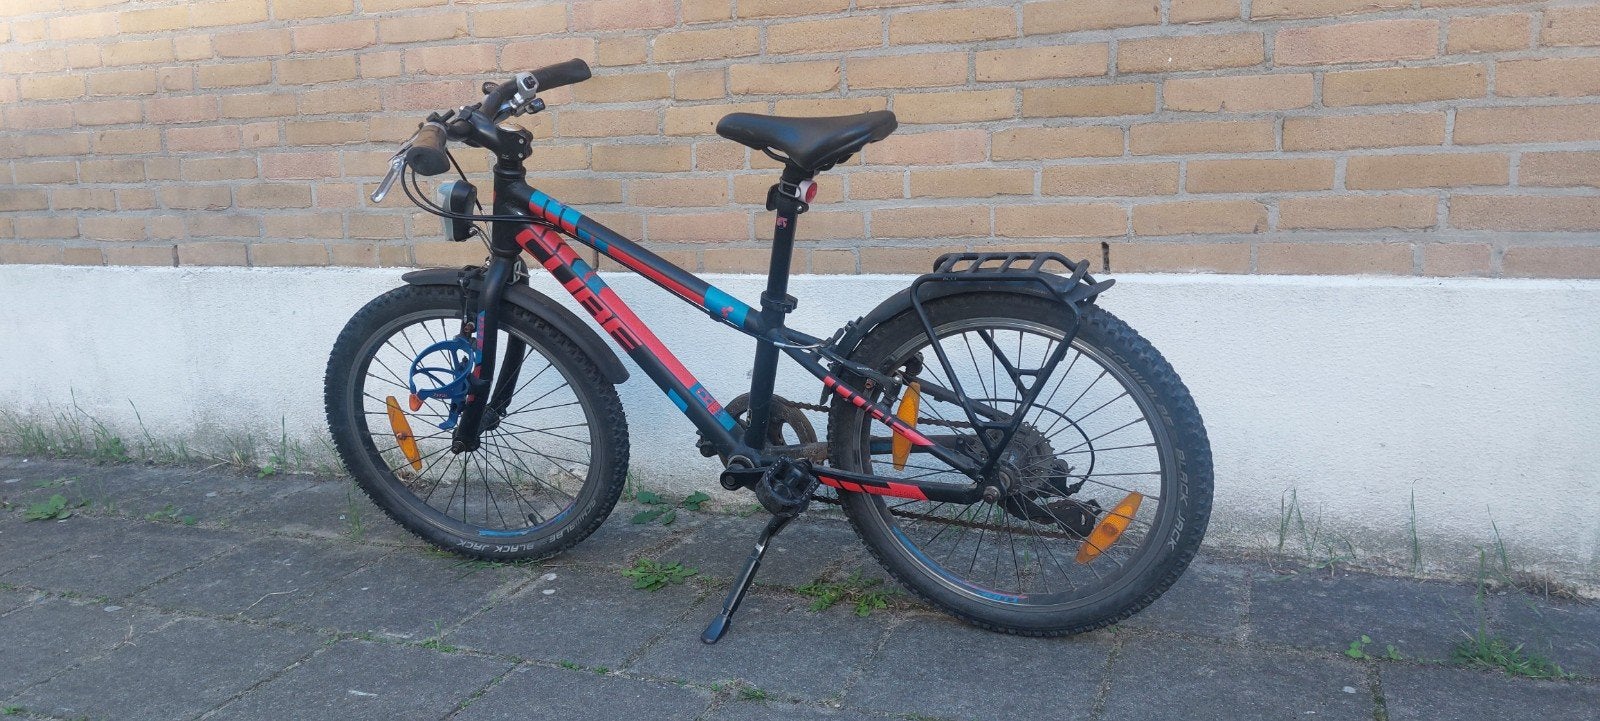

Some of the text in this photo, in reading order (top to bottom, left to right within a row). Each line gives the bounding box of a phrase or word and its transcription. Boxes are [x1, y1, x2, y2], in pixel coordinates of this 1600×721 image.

[515, 228, 643, 353] CUBE
[1104, 346, 1189, 552] SCHWALBE BLACK JACK
[457, 538, 490, 552] JACK
[493, 543, 534, 553] BLACK
